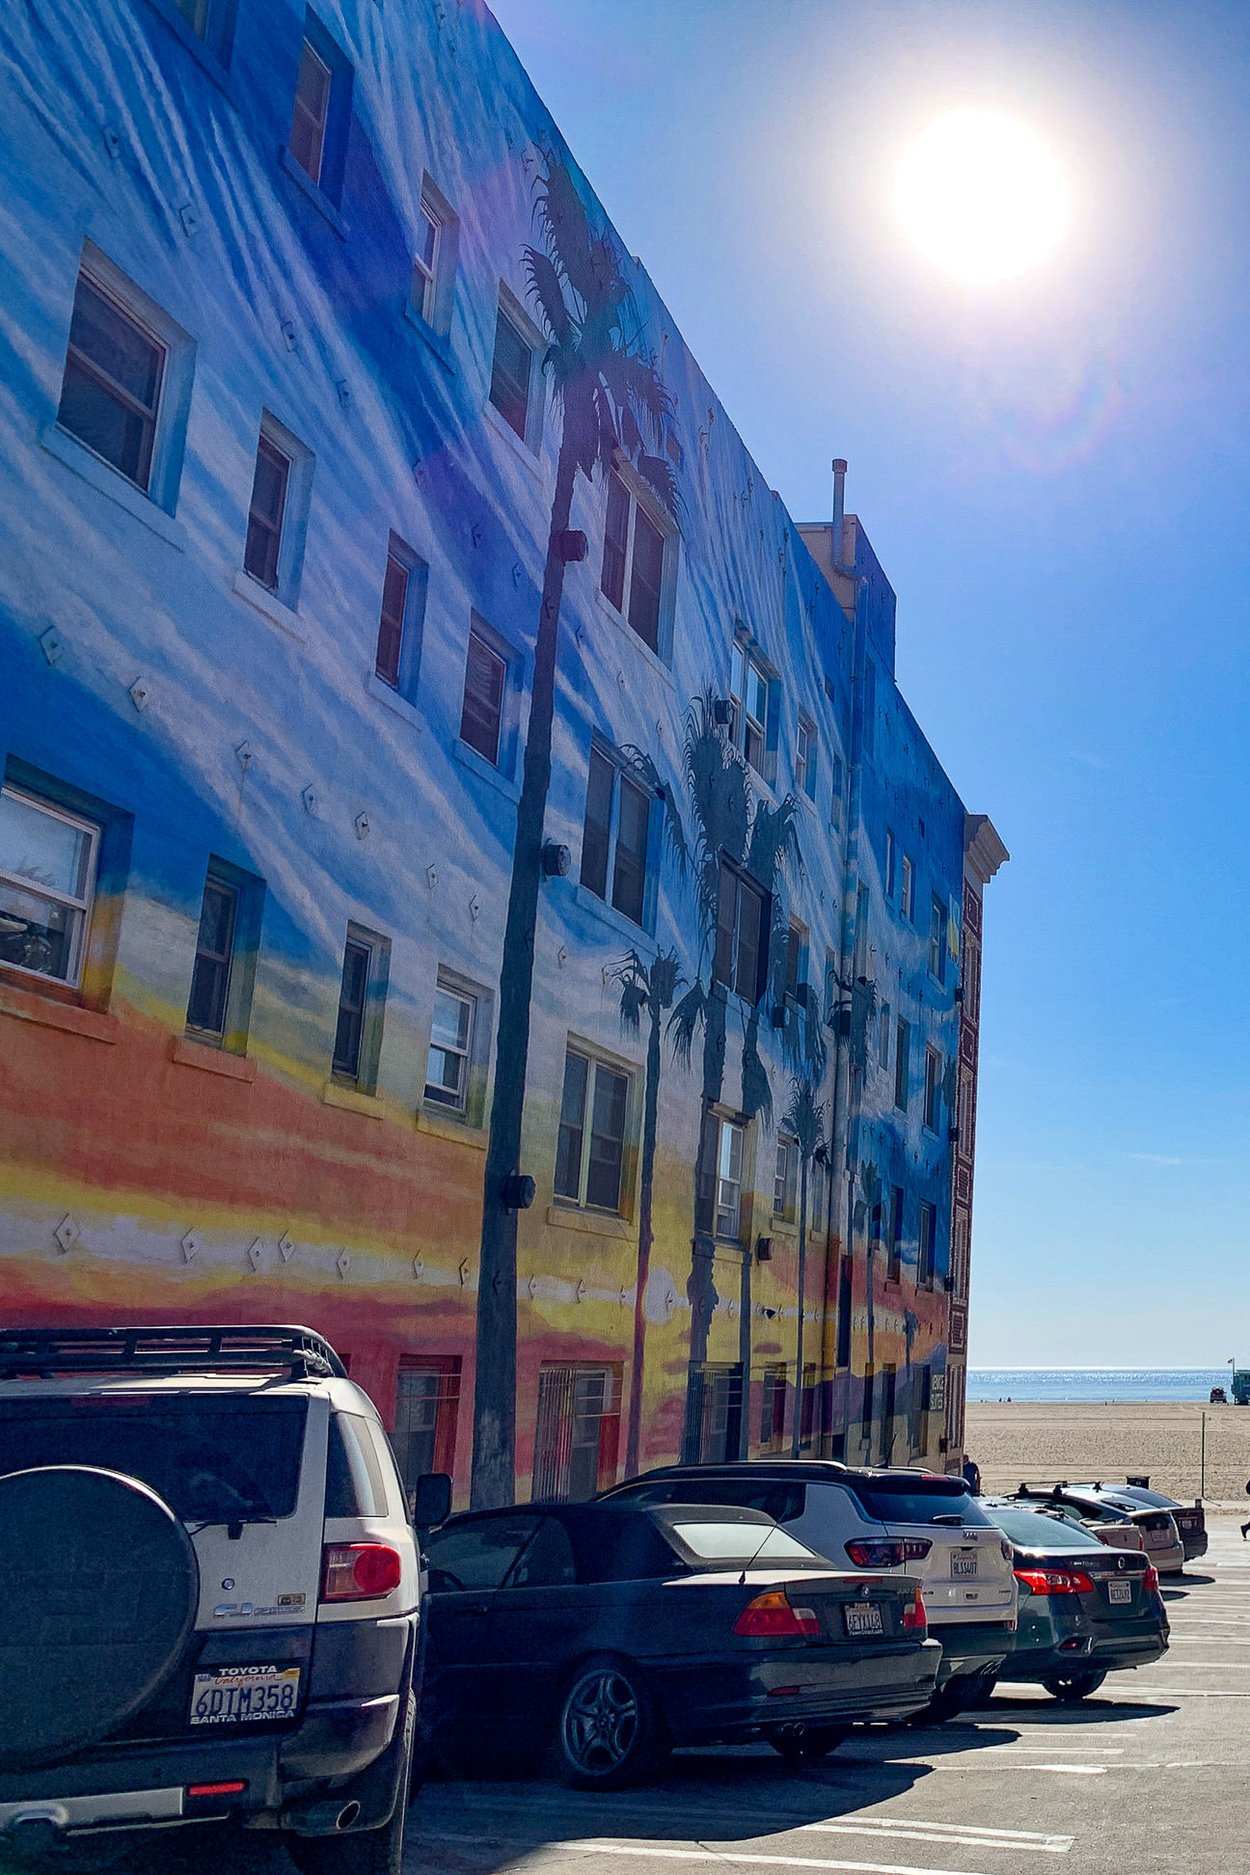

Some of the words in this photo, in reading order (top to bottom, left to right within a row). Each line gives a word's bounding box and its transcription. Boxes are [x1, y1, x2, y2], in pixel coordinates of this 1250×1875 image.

[219, 1665, 277, 1676] TOYOTA
[195, 1684, 294, 1716] 6DTM358
[190, 1714, 237, 1725] SANTA
[240, 1710, 294, 1721] MONICA
